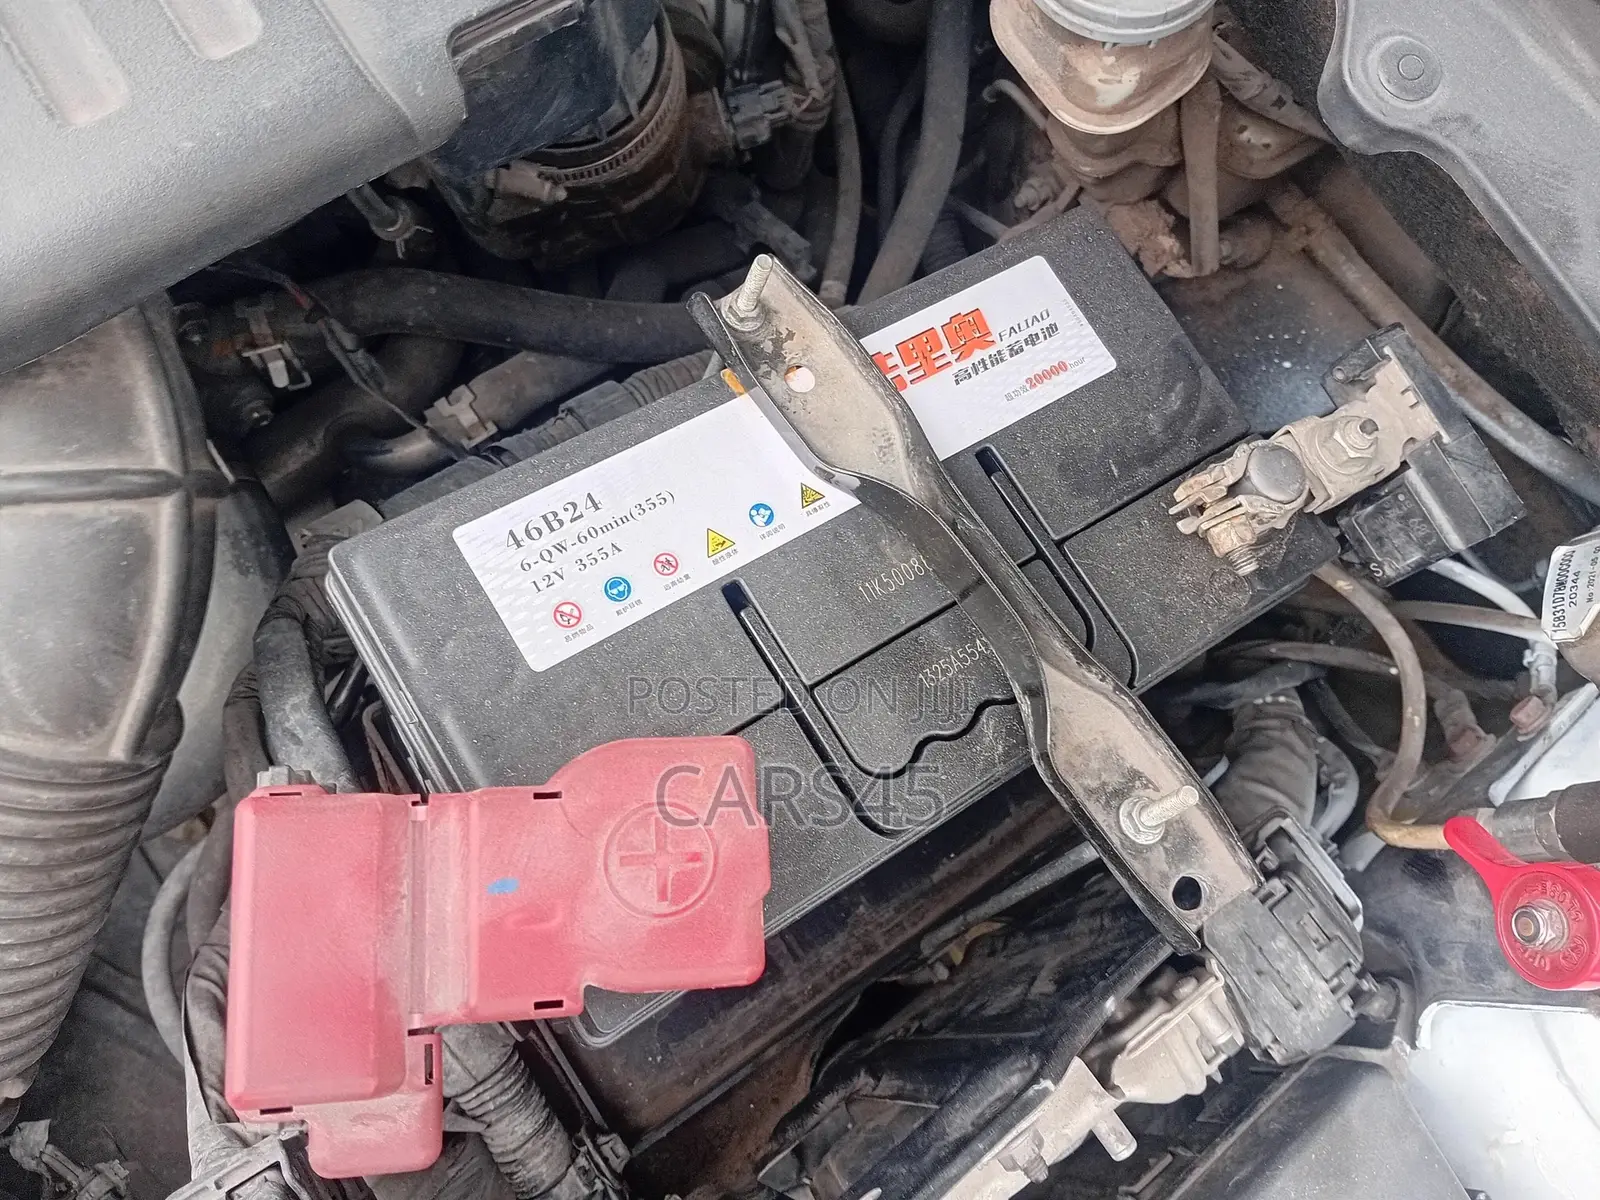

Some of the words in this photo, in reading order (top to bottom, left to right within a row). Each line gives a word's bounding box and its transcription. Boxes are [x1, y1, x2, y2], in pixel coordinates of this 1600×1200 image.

[998, 308, 1051, 342] FALIAO
[951, 324, 1060, 385] 高性能蓄电池
[1025, 360, 1069, 391] 20000
[1069, 356, 1086, 370] hour
[505, 492, 603, 552] 46B24
[520, 489, 676, 573] 6-QW-60min(355)
[530, 567, 566, 595] 12V
[575, 543, 624, 573] 355A
[1568, 570, 1581, 607] 20344
